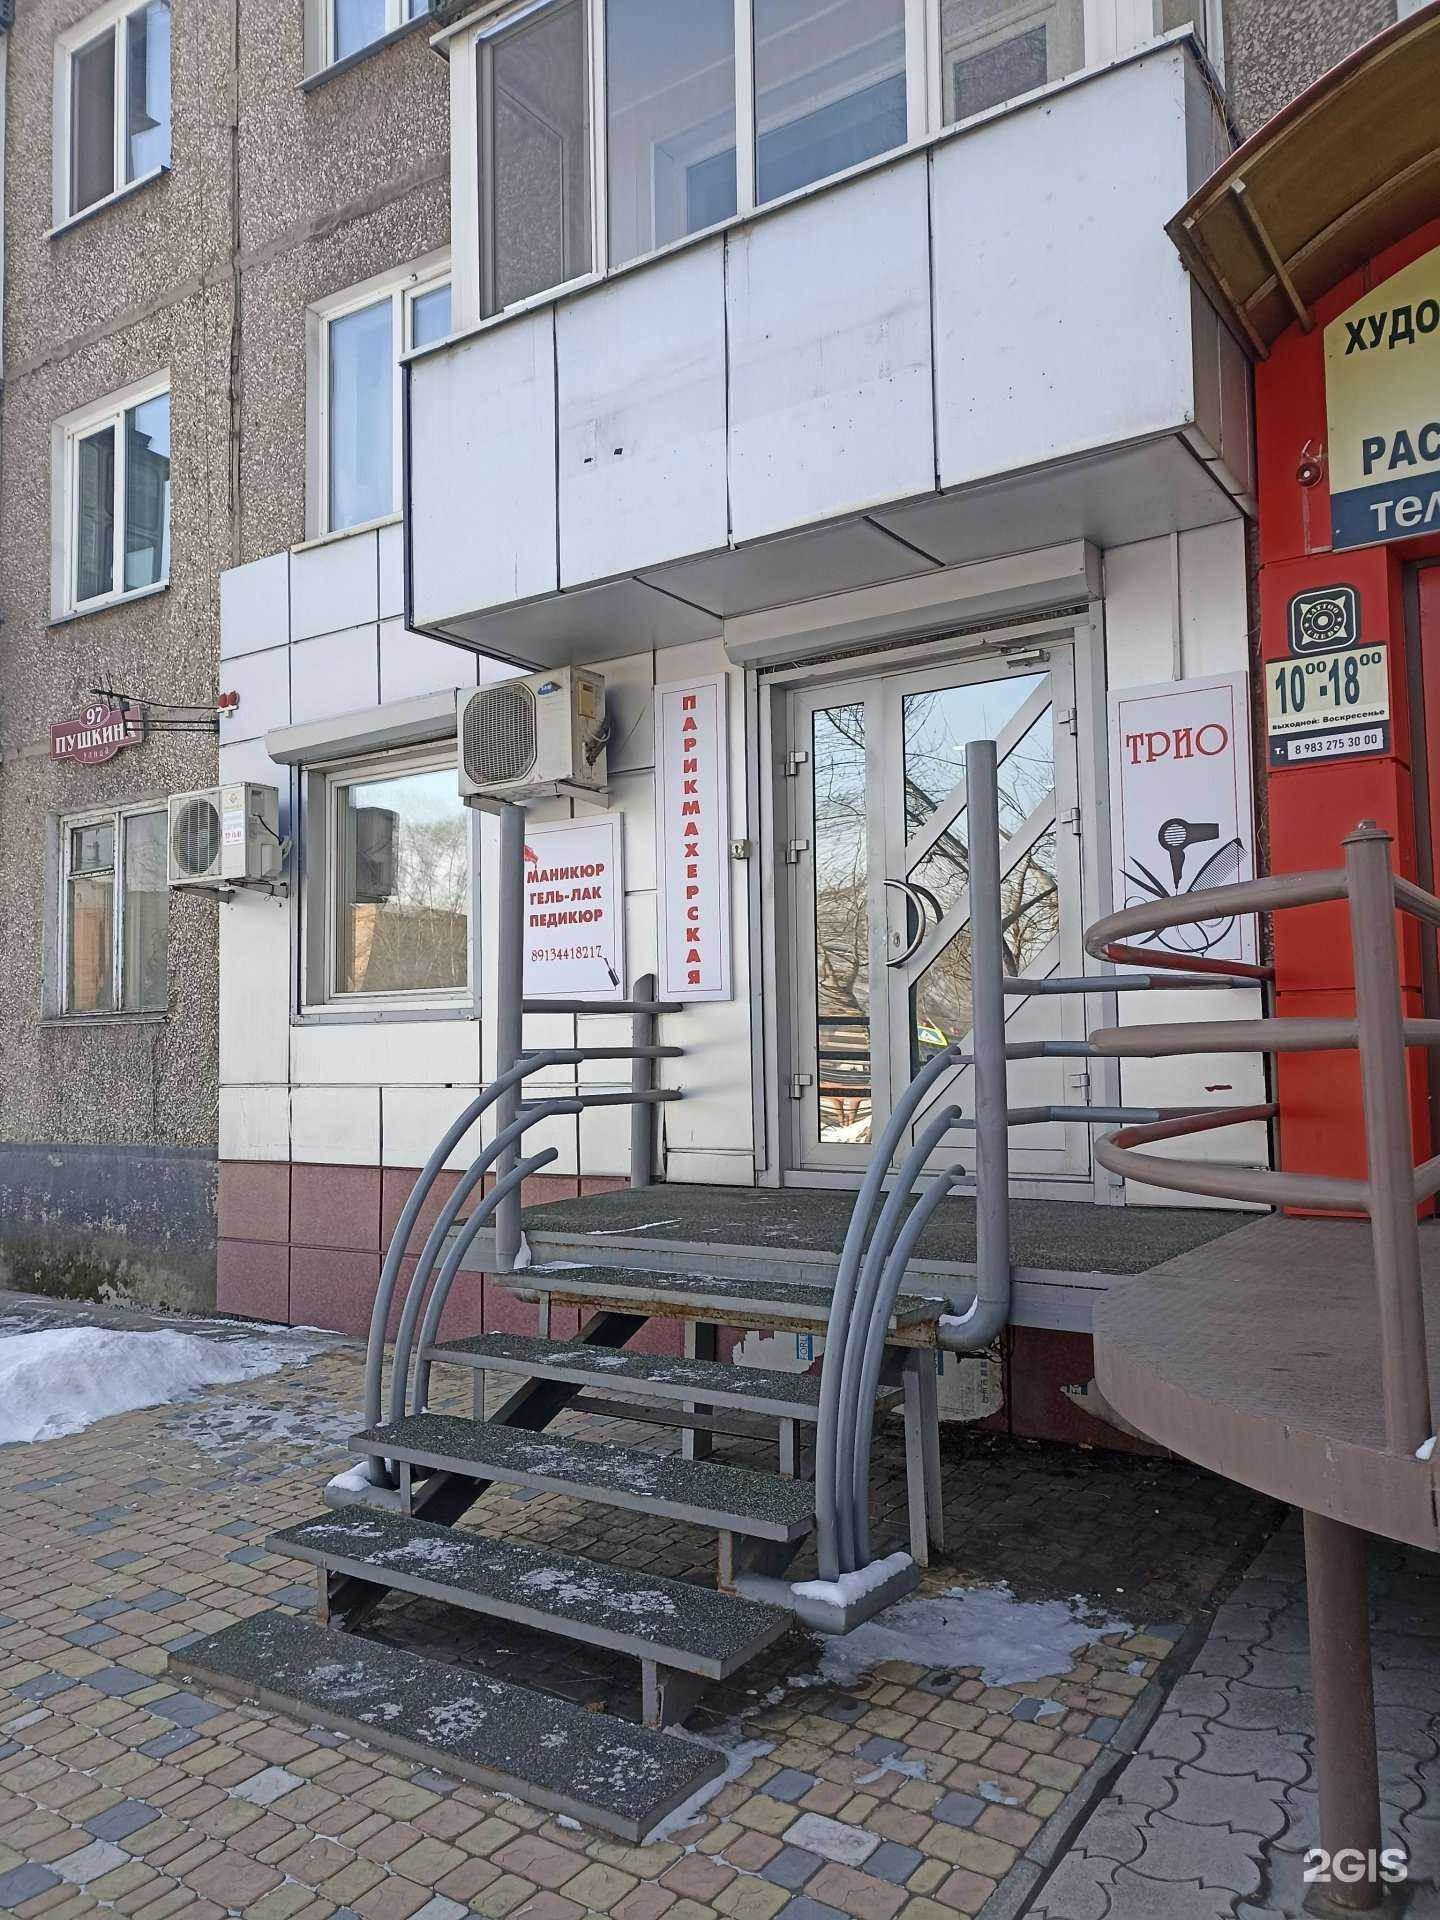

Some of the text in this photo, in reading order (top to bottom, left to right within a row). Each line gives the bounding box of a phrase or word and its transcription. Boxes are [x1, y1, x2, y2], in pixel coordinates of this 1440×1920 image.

[86, 706, 103, 725] 97
[1322, 709, 1385, 723] Воскресенье
[1125, 723, 1229, 765] ТРИО
[1295, 744, 1301, 754] 8
[1304, 741, 1323, 752] 983
[1326, 739, 1345, 751] 275
[1348, 737, 1361, 747] 30
[1364, 734, 1377, 745] 00
[682, 695, 701, 984] ПАРИКМАХЕРСКАЯ
[526, 863, 605, 884] МАНИКЮР
[529, 886, 602, 905] ГЕЛЬ-ЛАК
[529, 909, 603, 928] ПЕДИКЮР
[531, 945, 602, 962] 89134418217
